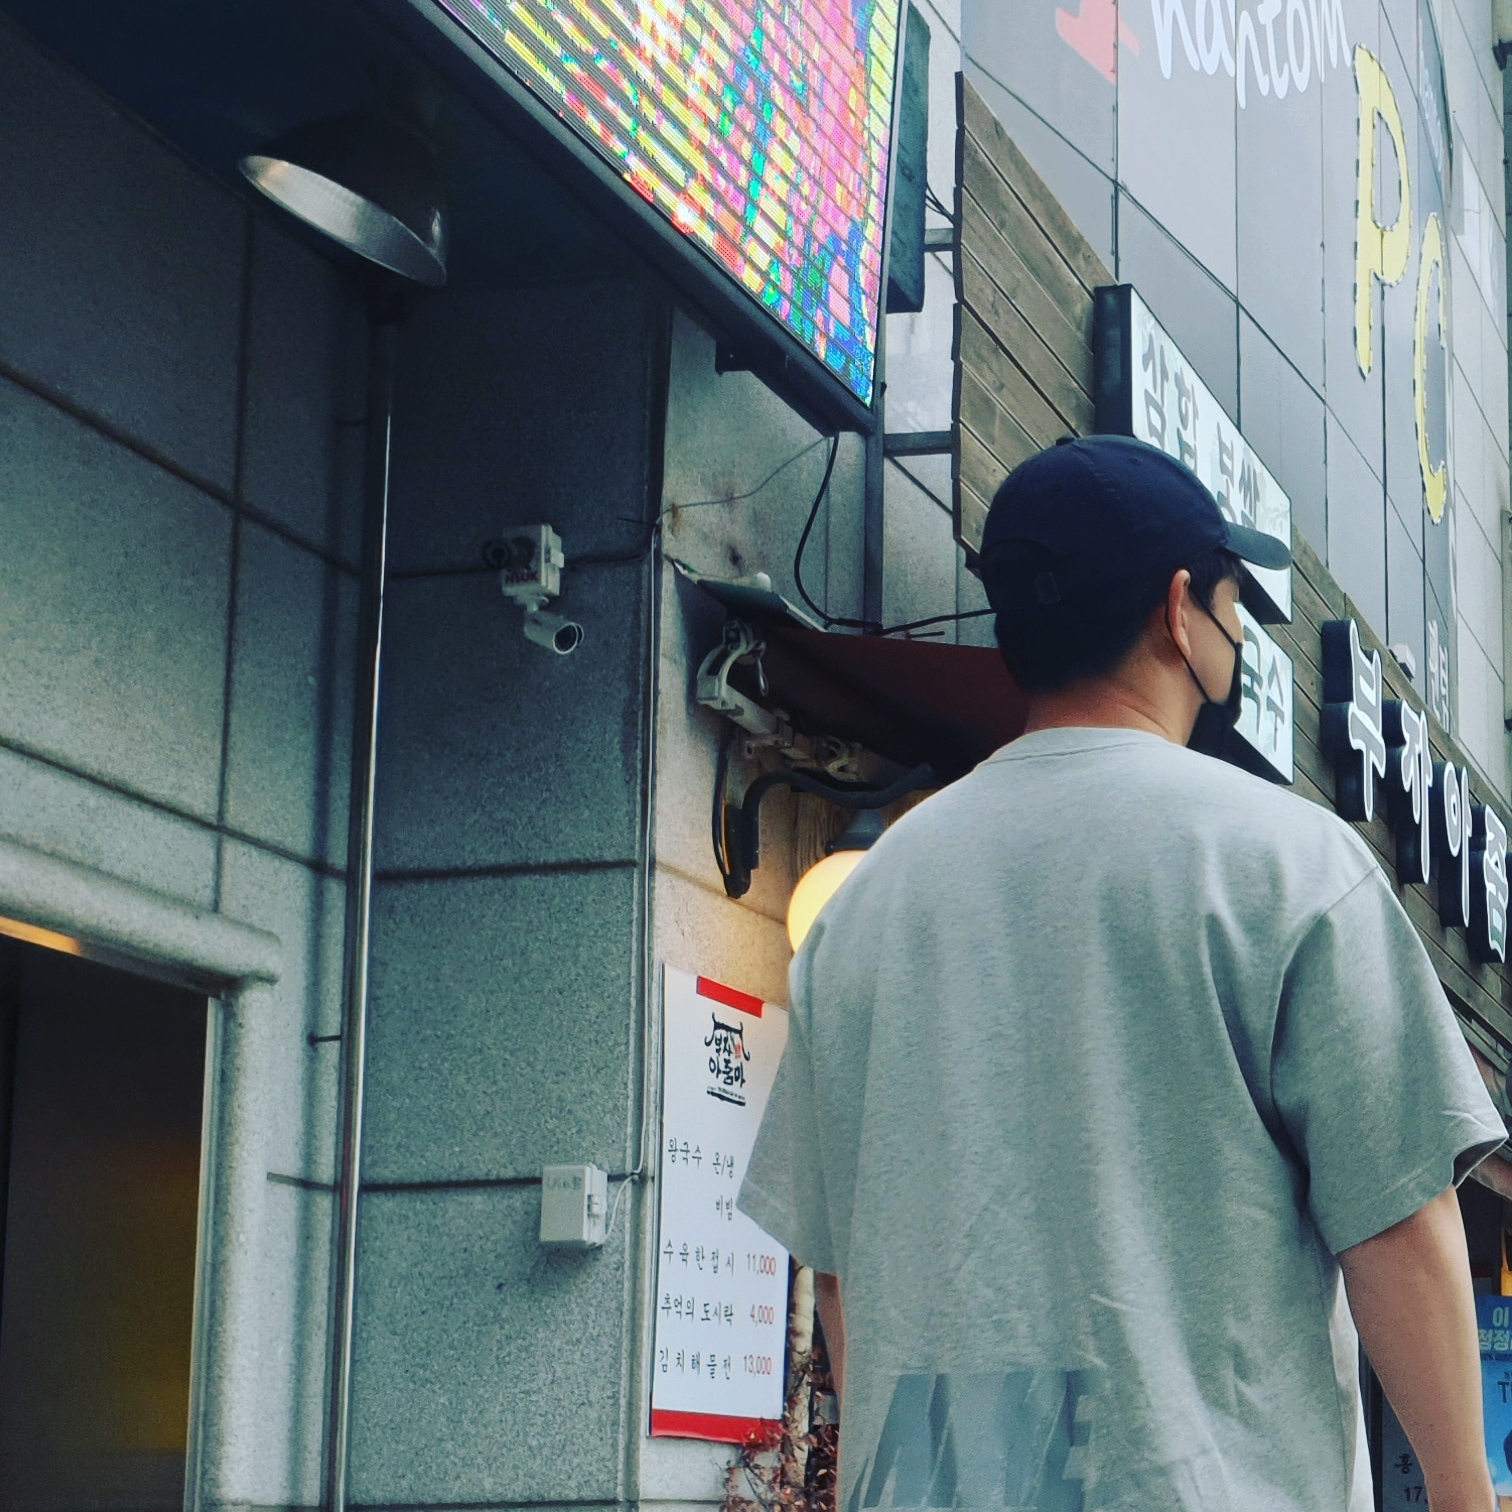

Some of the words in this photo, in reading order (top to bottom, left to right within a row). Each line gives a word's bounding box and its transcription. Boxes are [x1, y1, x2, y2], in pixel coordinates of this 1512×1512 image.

[1352, 41, 1447, 526] PC
[708, 1056, 747, 1088] 아줌마
[667, 1137, 703, 1169] 왕국수
[712, 1151, 735, 1179] 온/냉
[715, 1194, 734, 1221] 비빔
[746, 1252, 776, 1276] 11,000
[661, 1292, 695, 1321] 추억의
[701, 1301, 734, 1328] 도시락
[749, 1303, 774, 1327] 4,000
[1492, 1306, 1509, 1328] 이
[743, 1354, 772, 1378] 13,000
